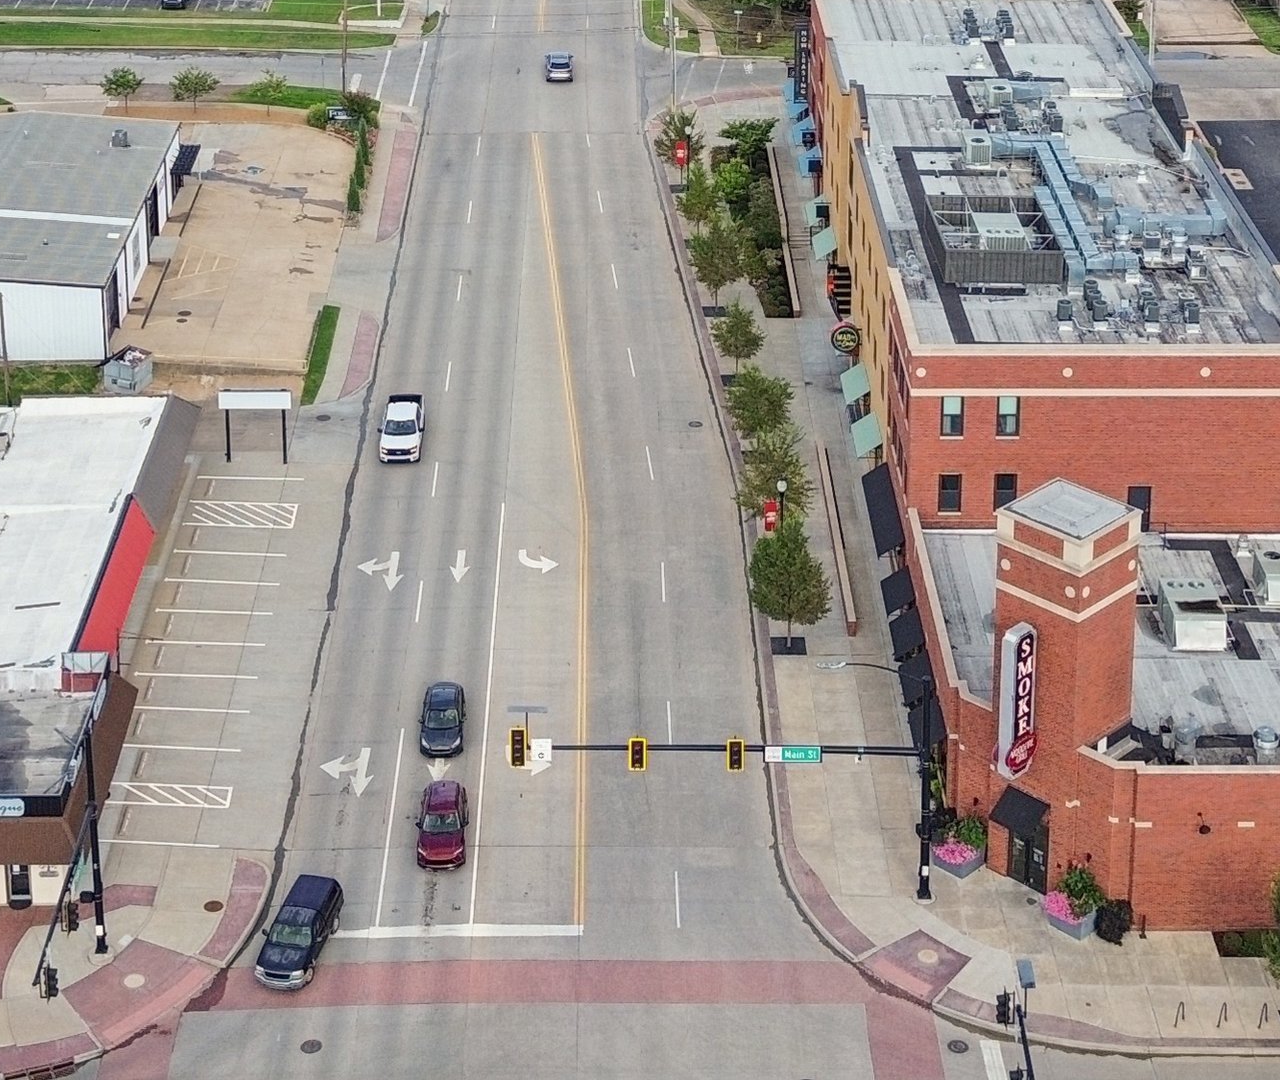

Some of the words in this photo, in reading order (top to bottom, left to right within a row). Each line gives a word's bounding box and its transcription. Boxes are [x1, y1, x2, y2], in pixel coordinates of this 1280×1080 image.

[1017, 637, 1033, 737] SMOKE
[784, 750, 805, 759] Main
[807, 750, 817, 759] St
